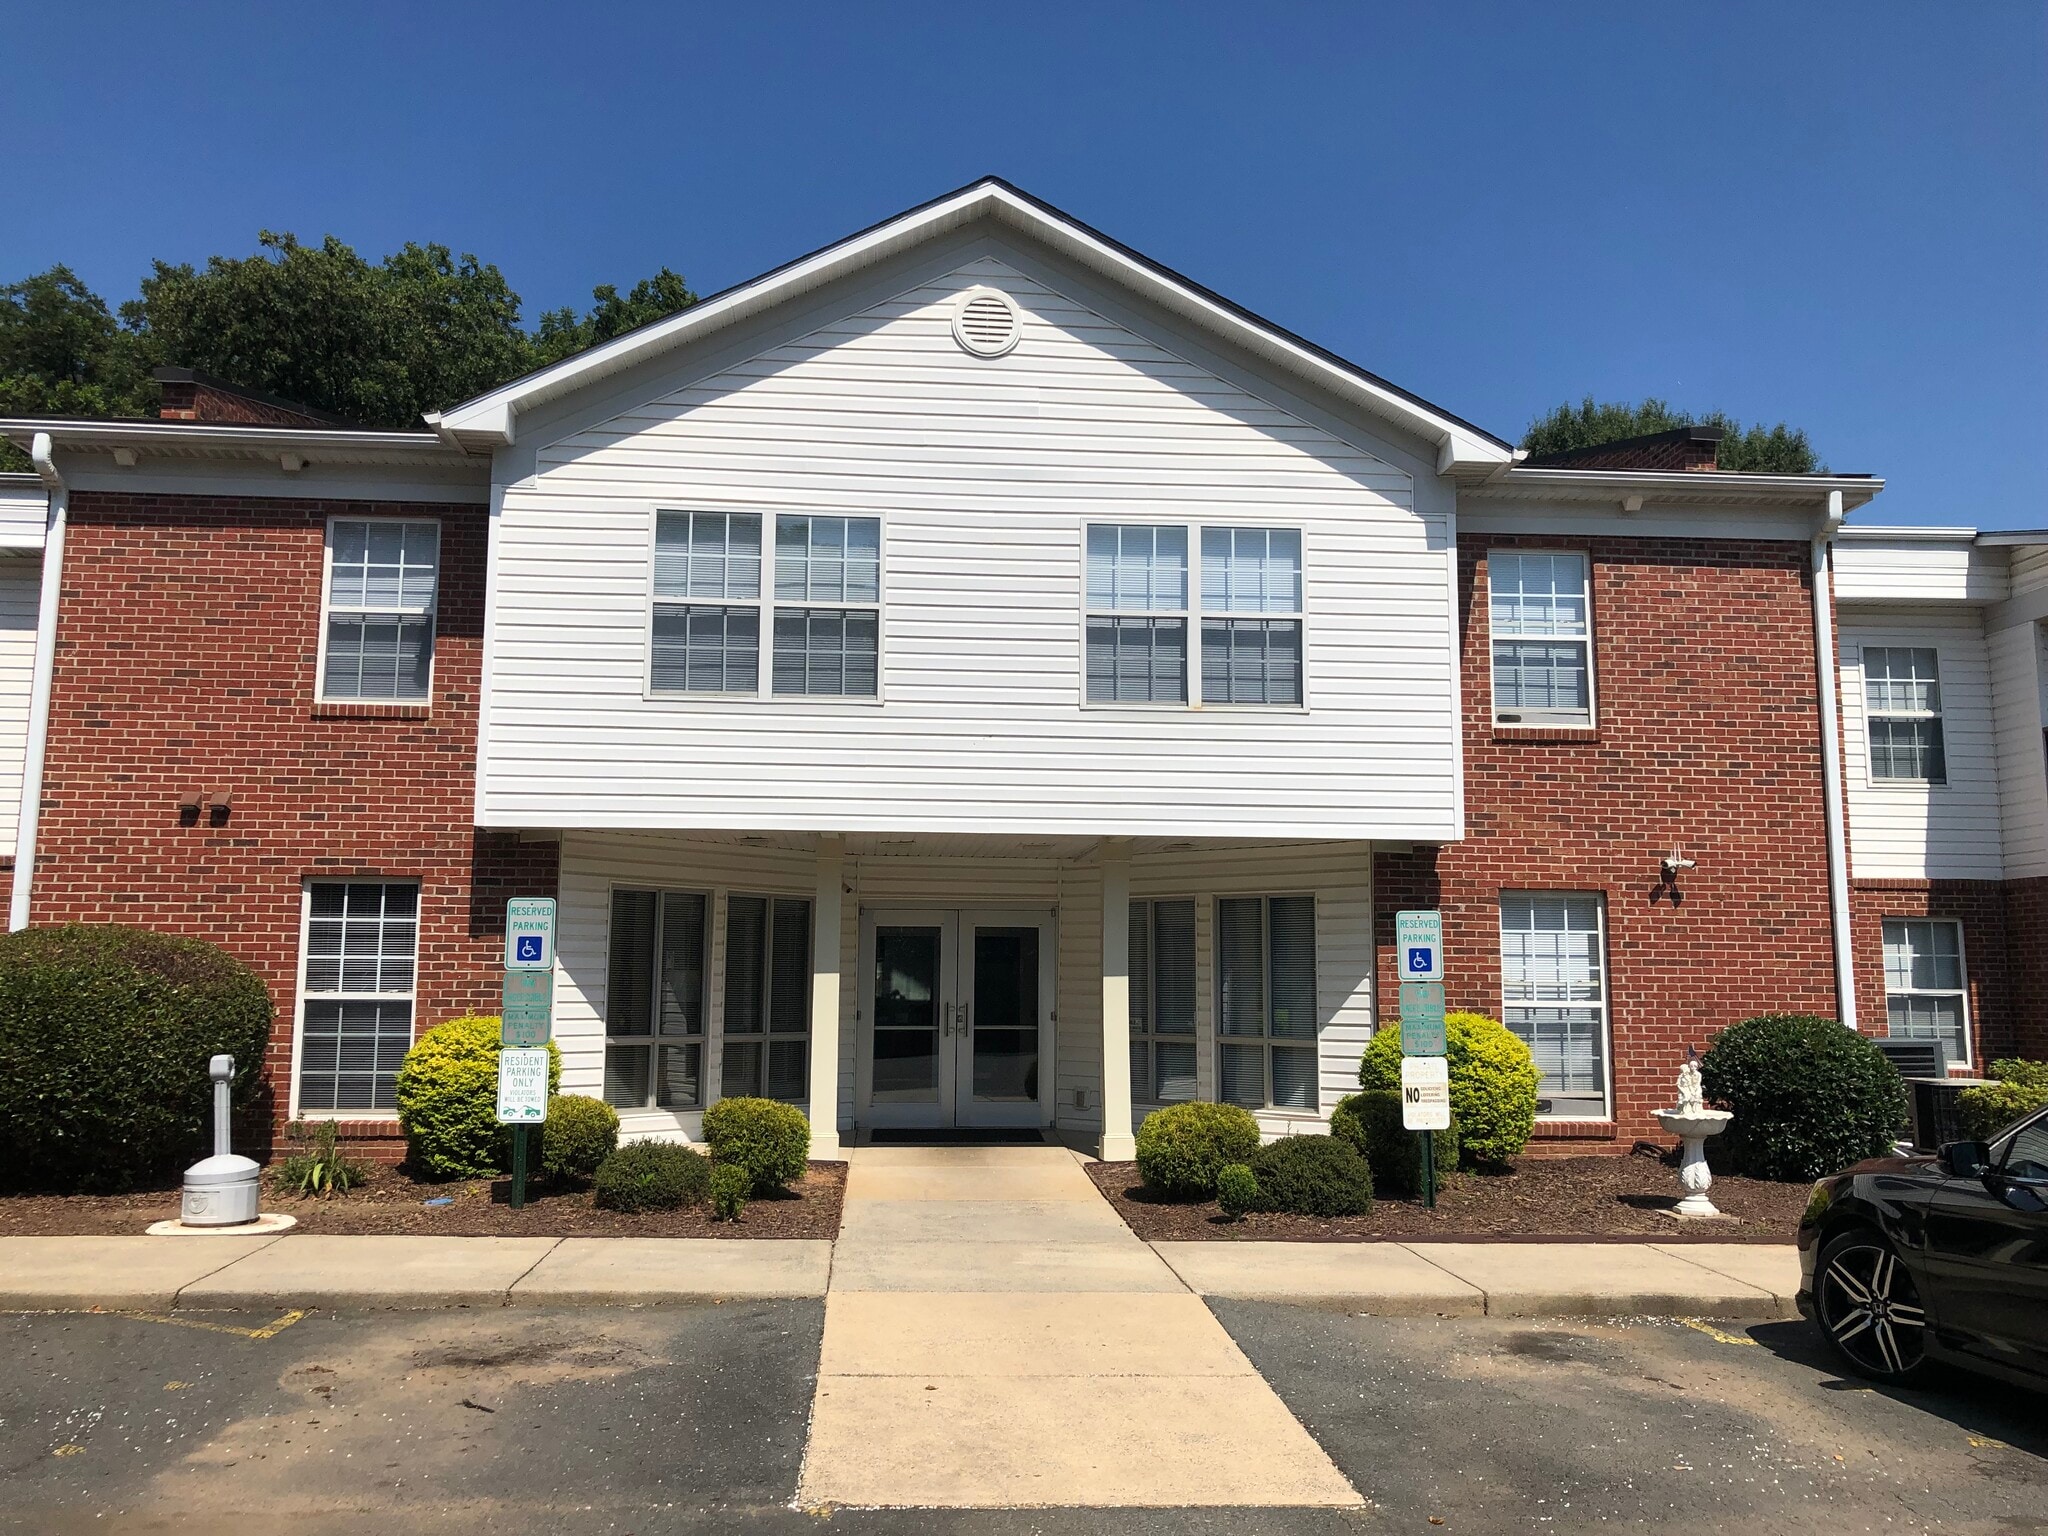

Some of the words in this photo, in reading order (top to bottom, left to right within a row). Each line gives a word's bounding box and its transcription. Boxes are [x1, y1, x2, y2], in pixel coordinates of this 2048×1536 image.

[511, 907, 552, 916] RESERVED
[512, 921, 549, 931] PARKING
[1400, 919, 1439, 928] RESERVED
[1402, 934, 1436, 943] PARKING
[504, 1056, 544, 1066] RESIDENT
[506, 1067, 541, 1077] PARKING
[512, 1077, 534, 1087] ONLY
[1405, 1087, 1420, 1103] NO
